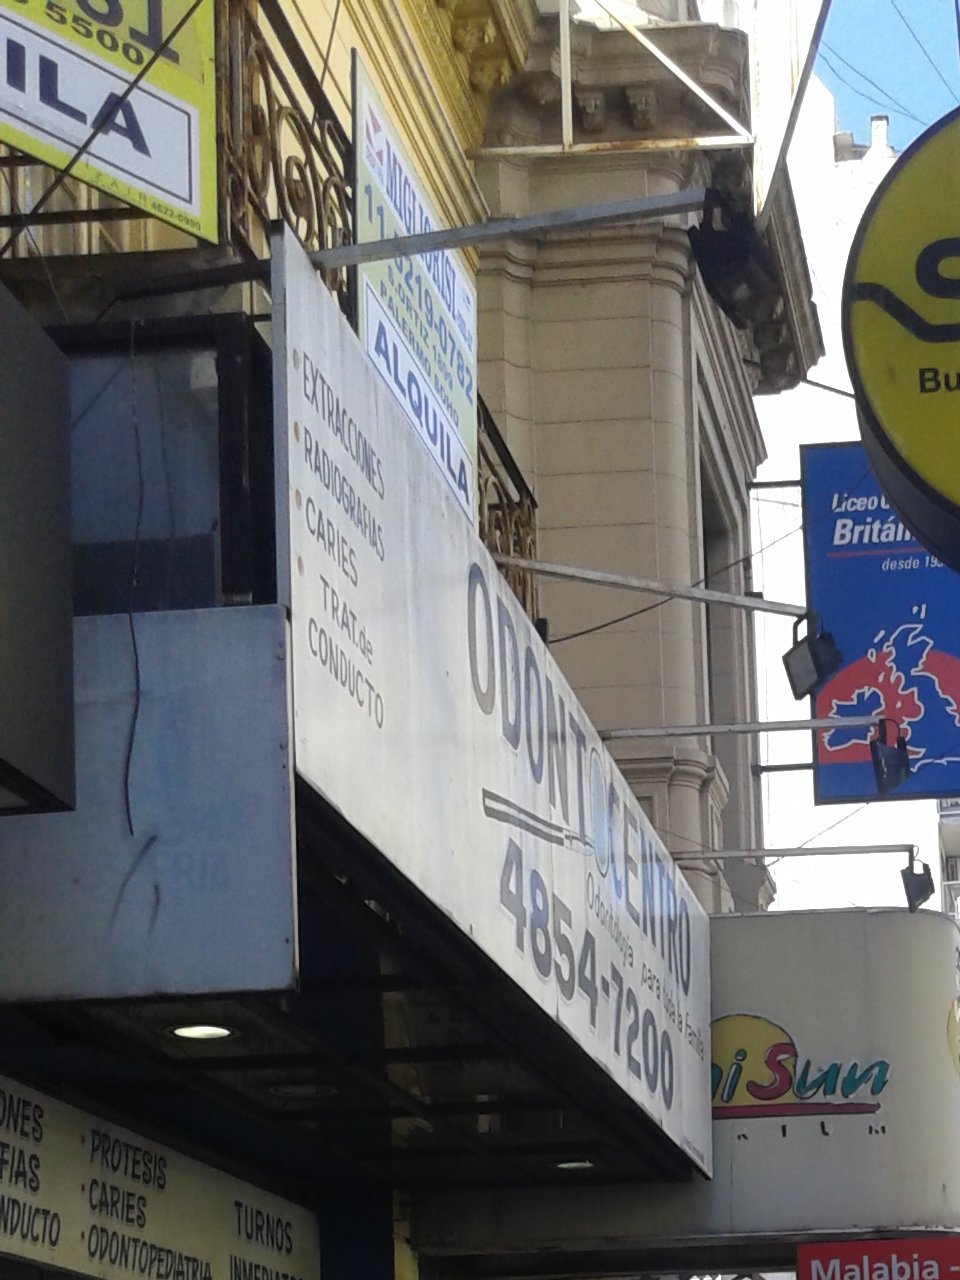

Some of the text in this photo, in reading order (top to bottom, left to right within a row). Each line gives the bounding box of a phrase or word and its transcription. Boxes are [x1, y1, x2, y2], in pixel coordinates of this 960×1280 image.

[303, 351, 386, 500] EXTRACCIONES
[374, 320, 470, 504] ALQUILA
[304, 426, 386, 562] RADIOGRAFIAS
[832, 493, 878, 513] Liceo
[306, 496, 359, 587] CARIES
[833, 517, 914, 546] Britán
[881, 557, 920, 572] desde
[308, 616, 385, 730] CONDUCTO
[499, 836, 675, 1112] 4854-7200
[712, 1048, 889, 1103] iSun
[90, 1128, 168, 1190] PROTESIS
[88, 1179, 148, 1229] CARIES
[234, 1200, 294, 1255] TURNOS
